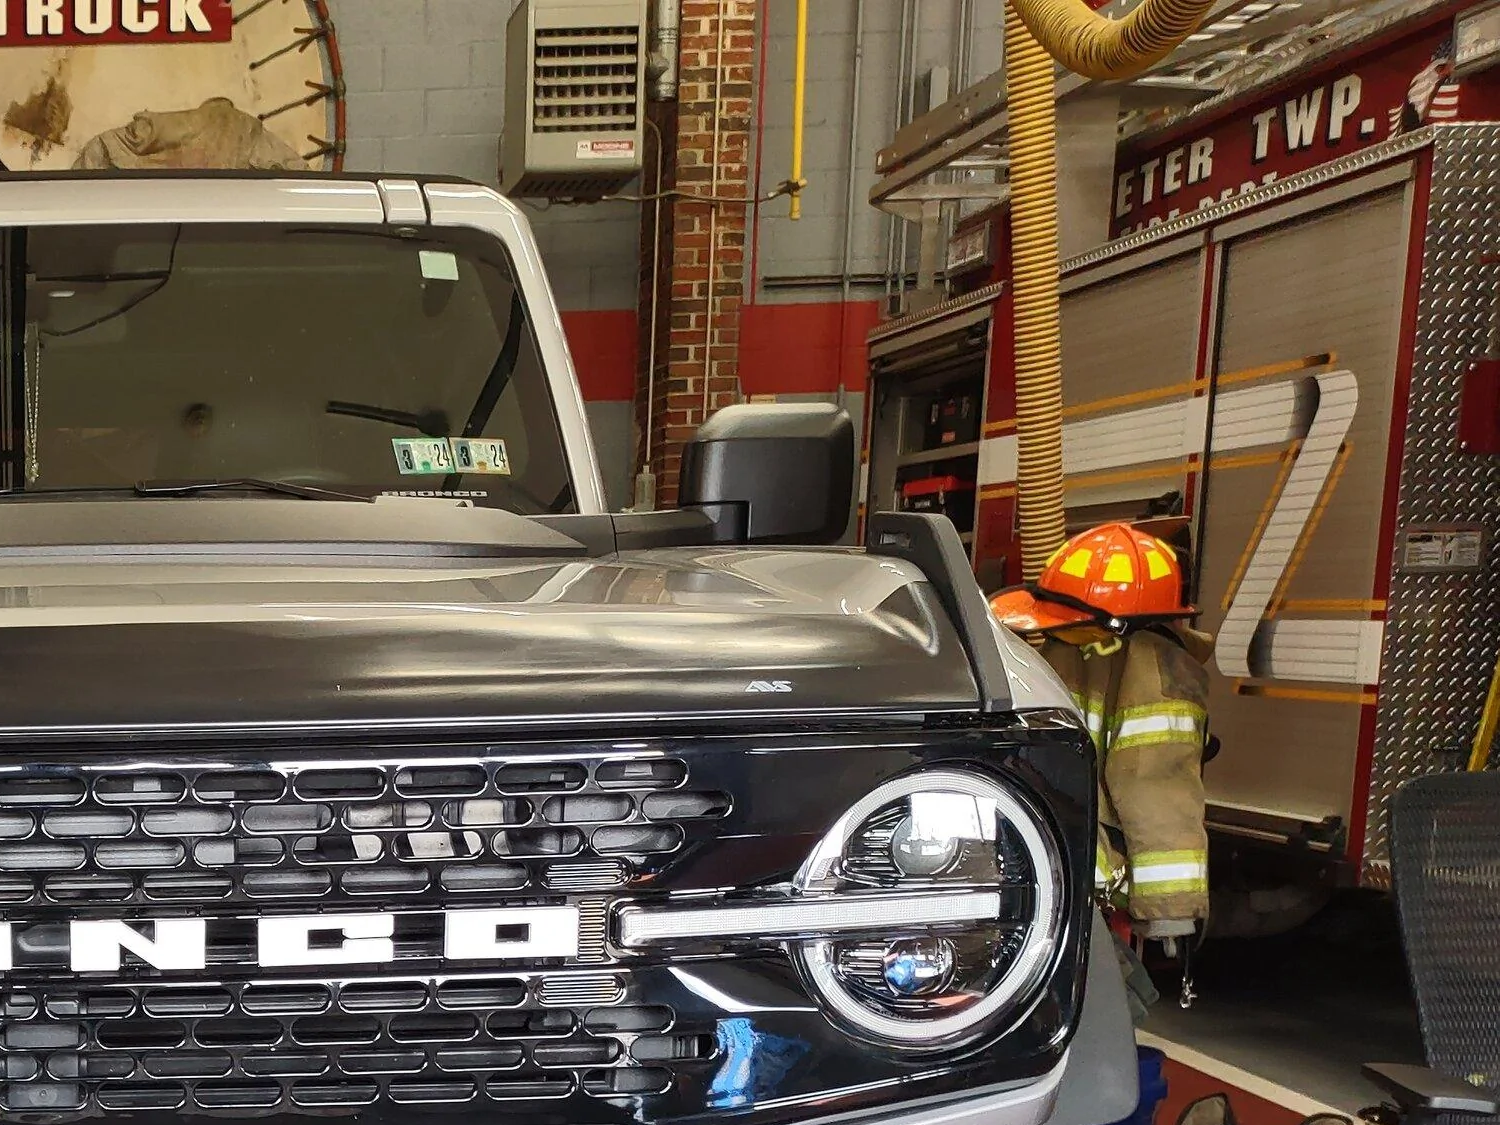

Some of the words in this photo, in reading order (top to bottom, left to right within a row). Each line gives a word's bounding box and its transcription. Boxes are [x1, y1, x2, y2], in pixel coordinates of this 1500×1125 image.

[1252, 73, 1375, 160] TWP.
[402, 449, 413, 470] 3
[433, 443, 450, 466] 24
[460, 446, 471, 467] 3
[491, 444, 506, 468] 24
[745, 680, 792, 692] AVS
